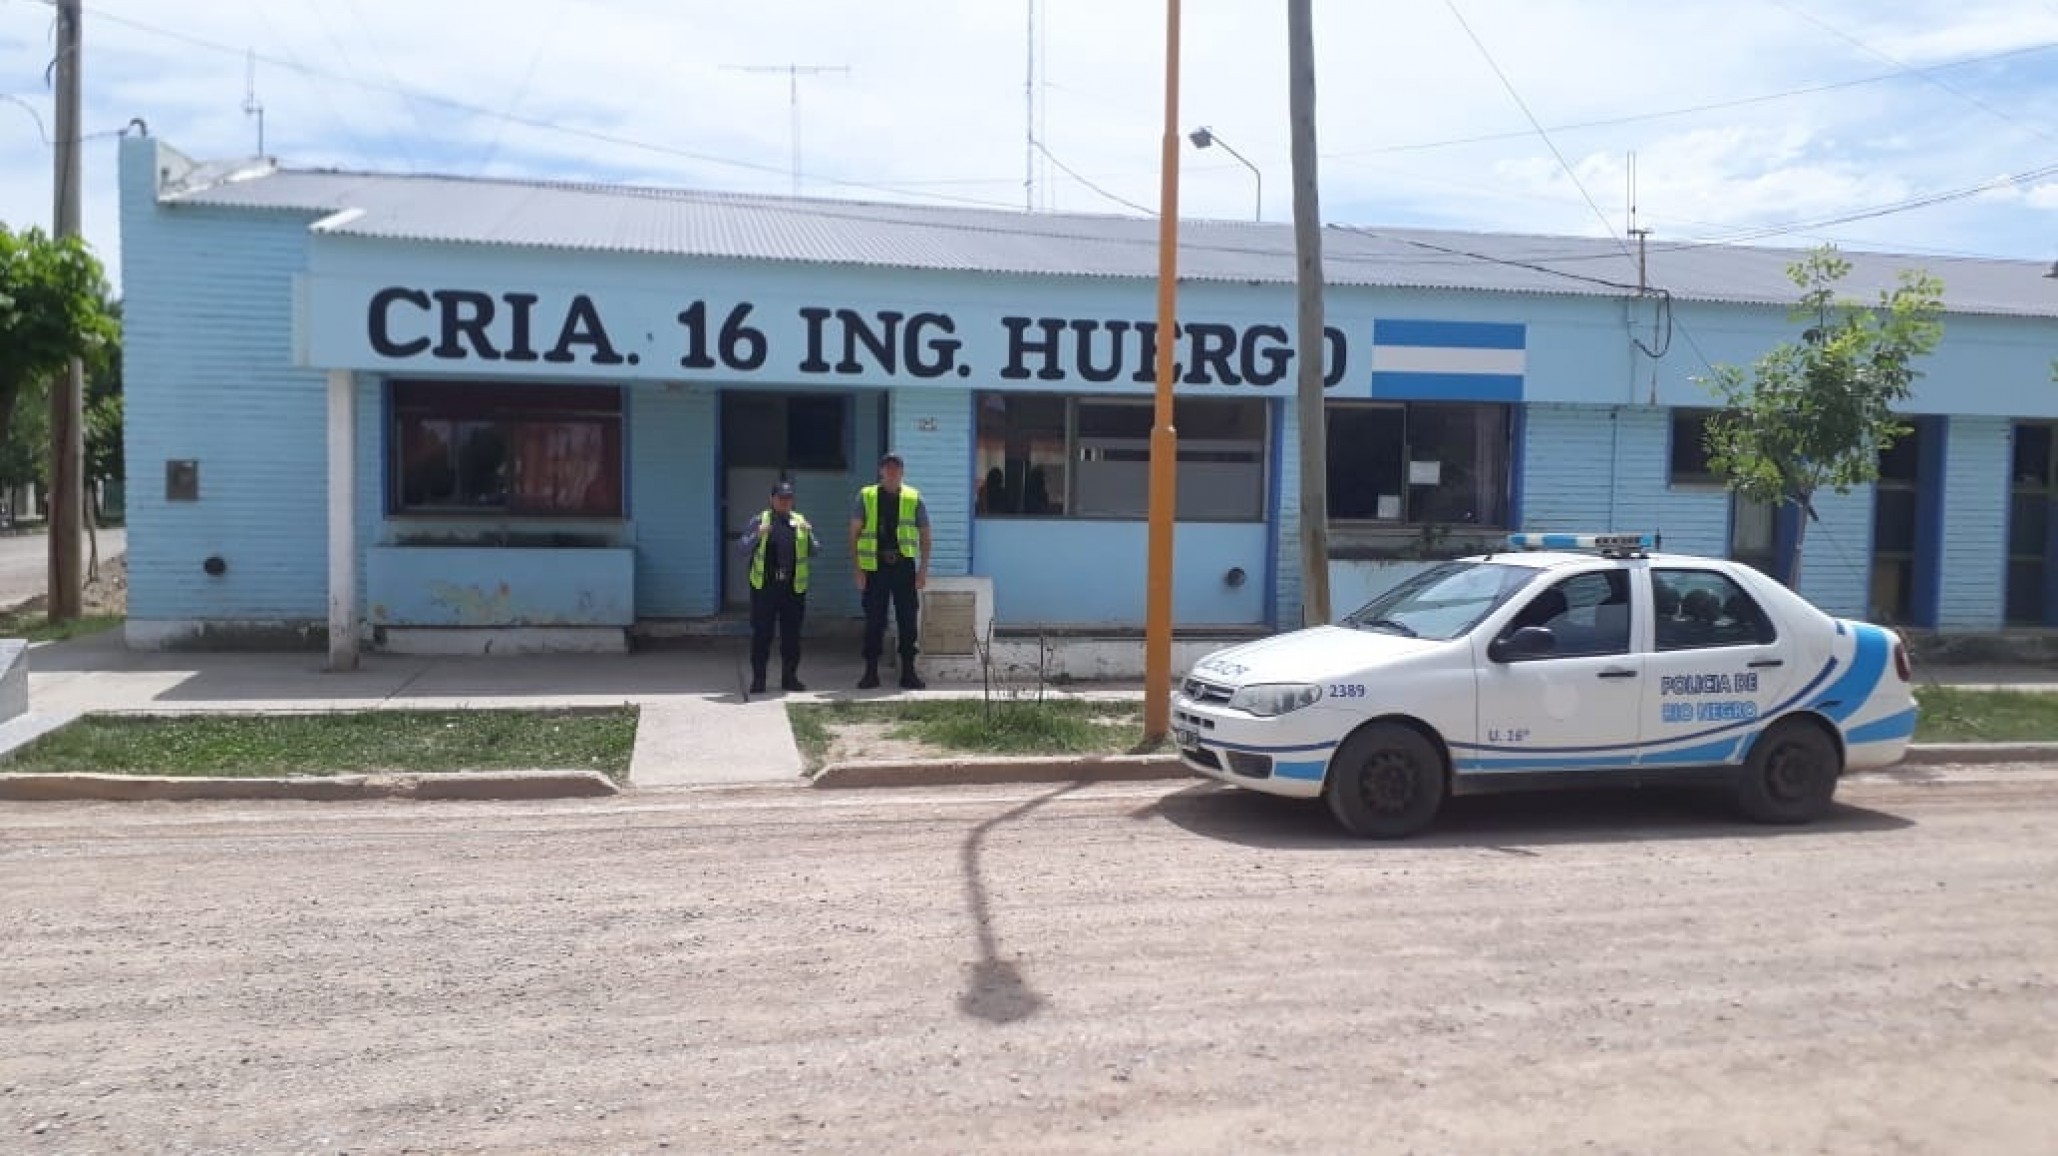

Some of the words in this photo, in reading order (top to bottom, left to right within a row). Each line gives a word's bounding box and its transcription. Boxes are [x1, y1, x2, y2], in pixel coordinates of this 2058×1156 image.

[368, 286, 640, 365] CRIA.
[677, 300, 768, 370] 16
[799, 308, 971, 378] ING.
[1329, 684, 1365, 698] 2389
[1660, 674, 1732, 696] POLICIA
[1734, 672, 1758, 693] DE
[1696, 700, 1758, 721] NEGRO
